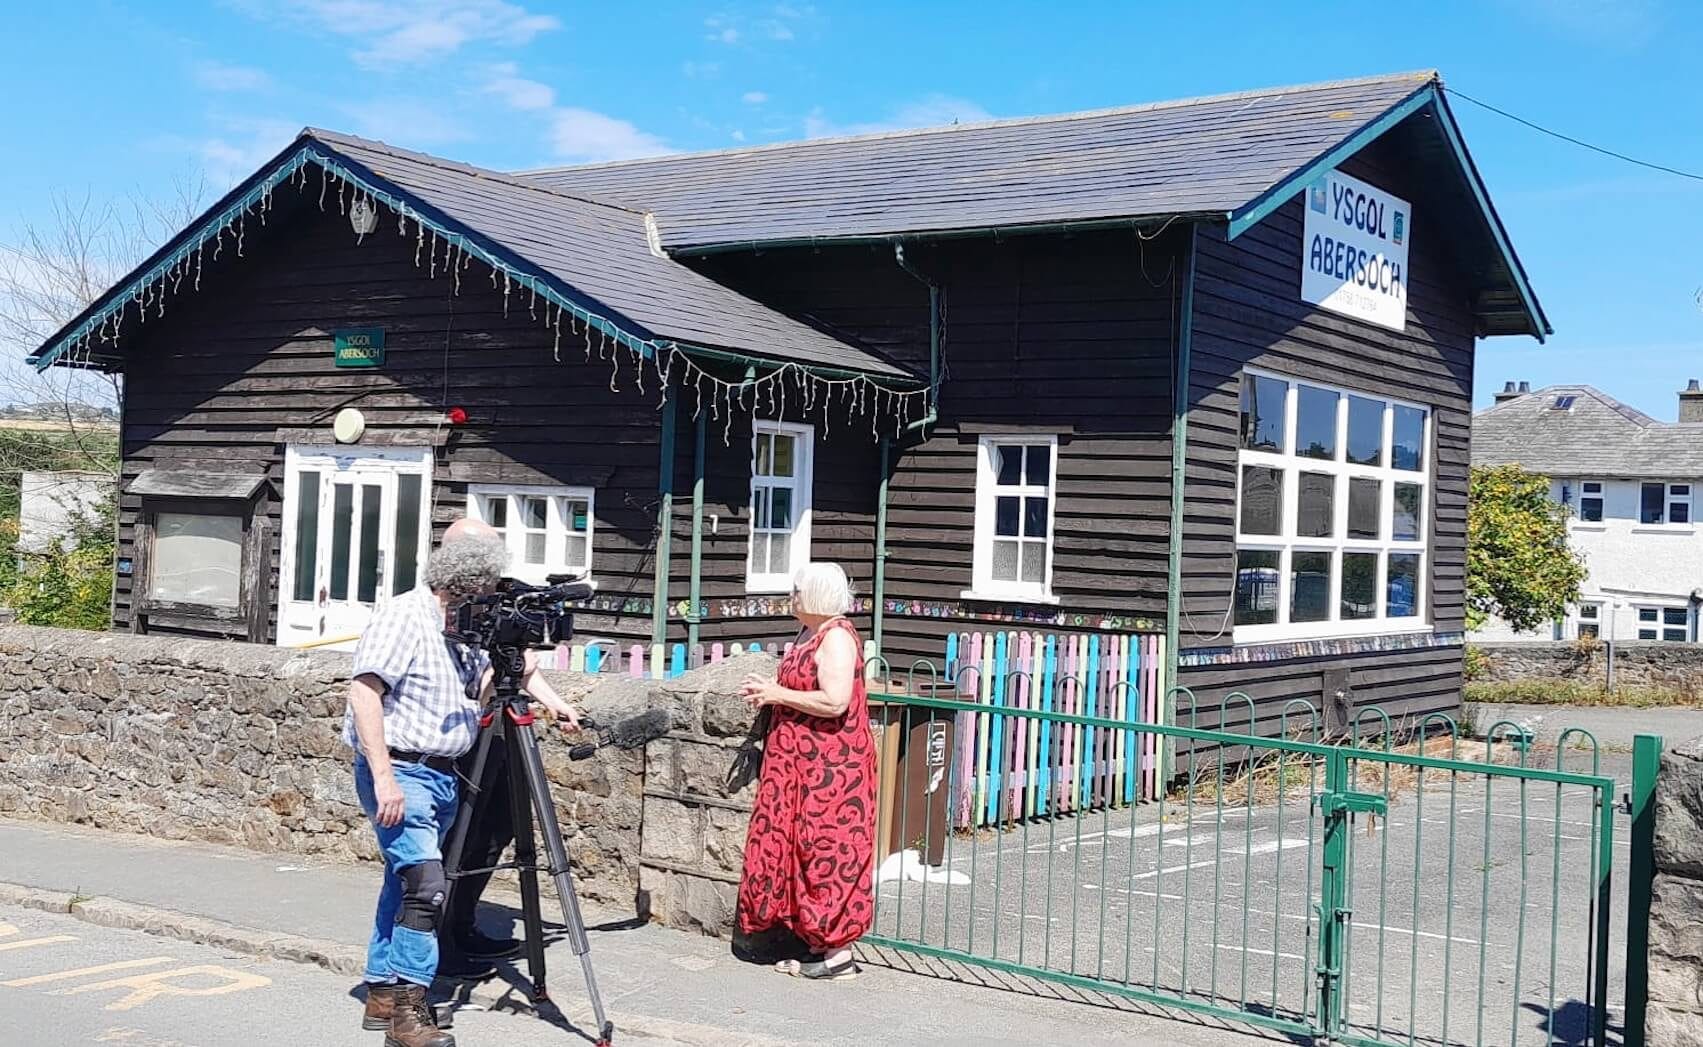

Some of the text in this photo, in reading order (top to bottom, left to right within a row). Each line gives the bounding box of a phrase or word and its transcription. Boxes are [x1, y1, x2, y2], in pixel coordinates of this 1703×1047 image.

[1332, 182, 1386, 240] YSGOL
[1310, 233, 1401, 299] ABERSOCH
[338, 347, 380, 360] ABERSOCH
[346, 334, 370, 346] YSGOL
